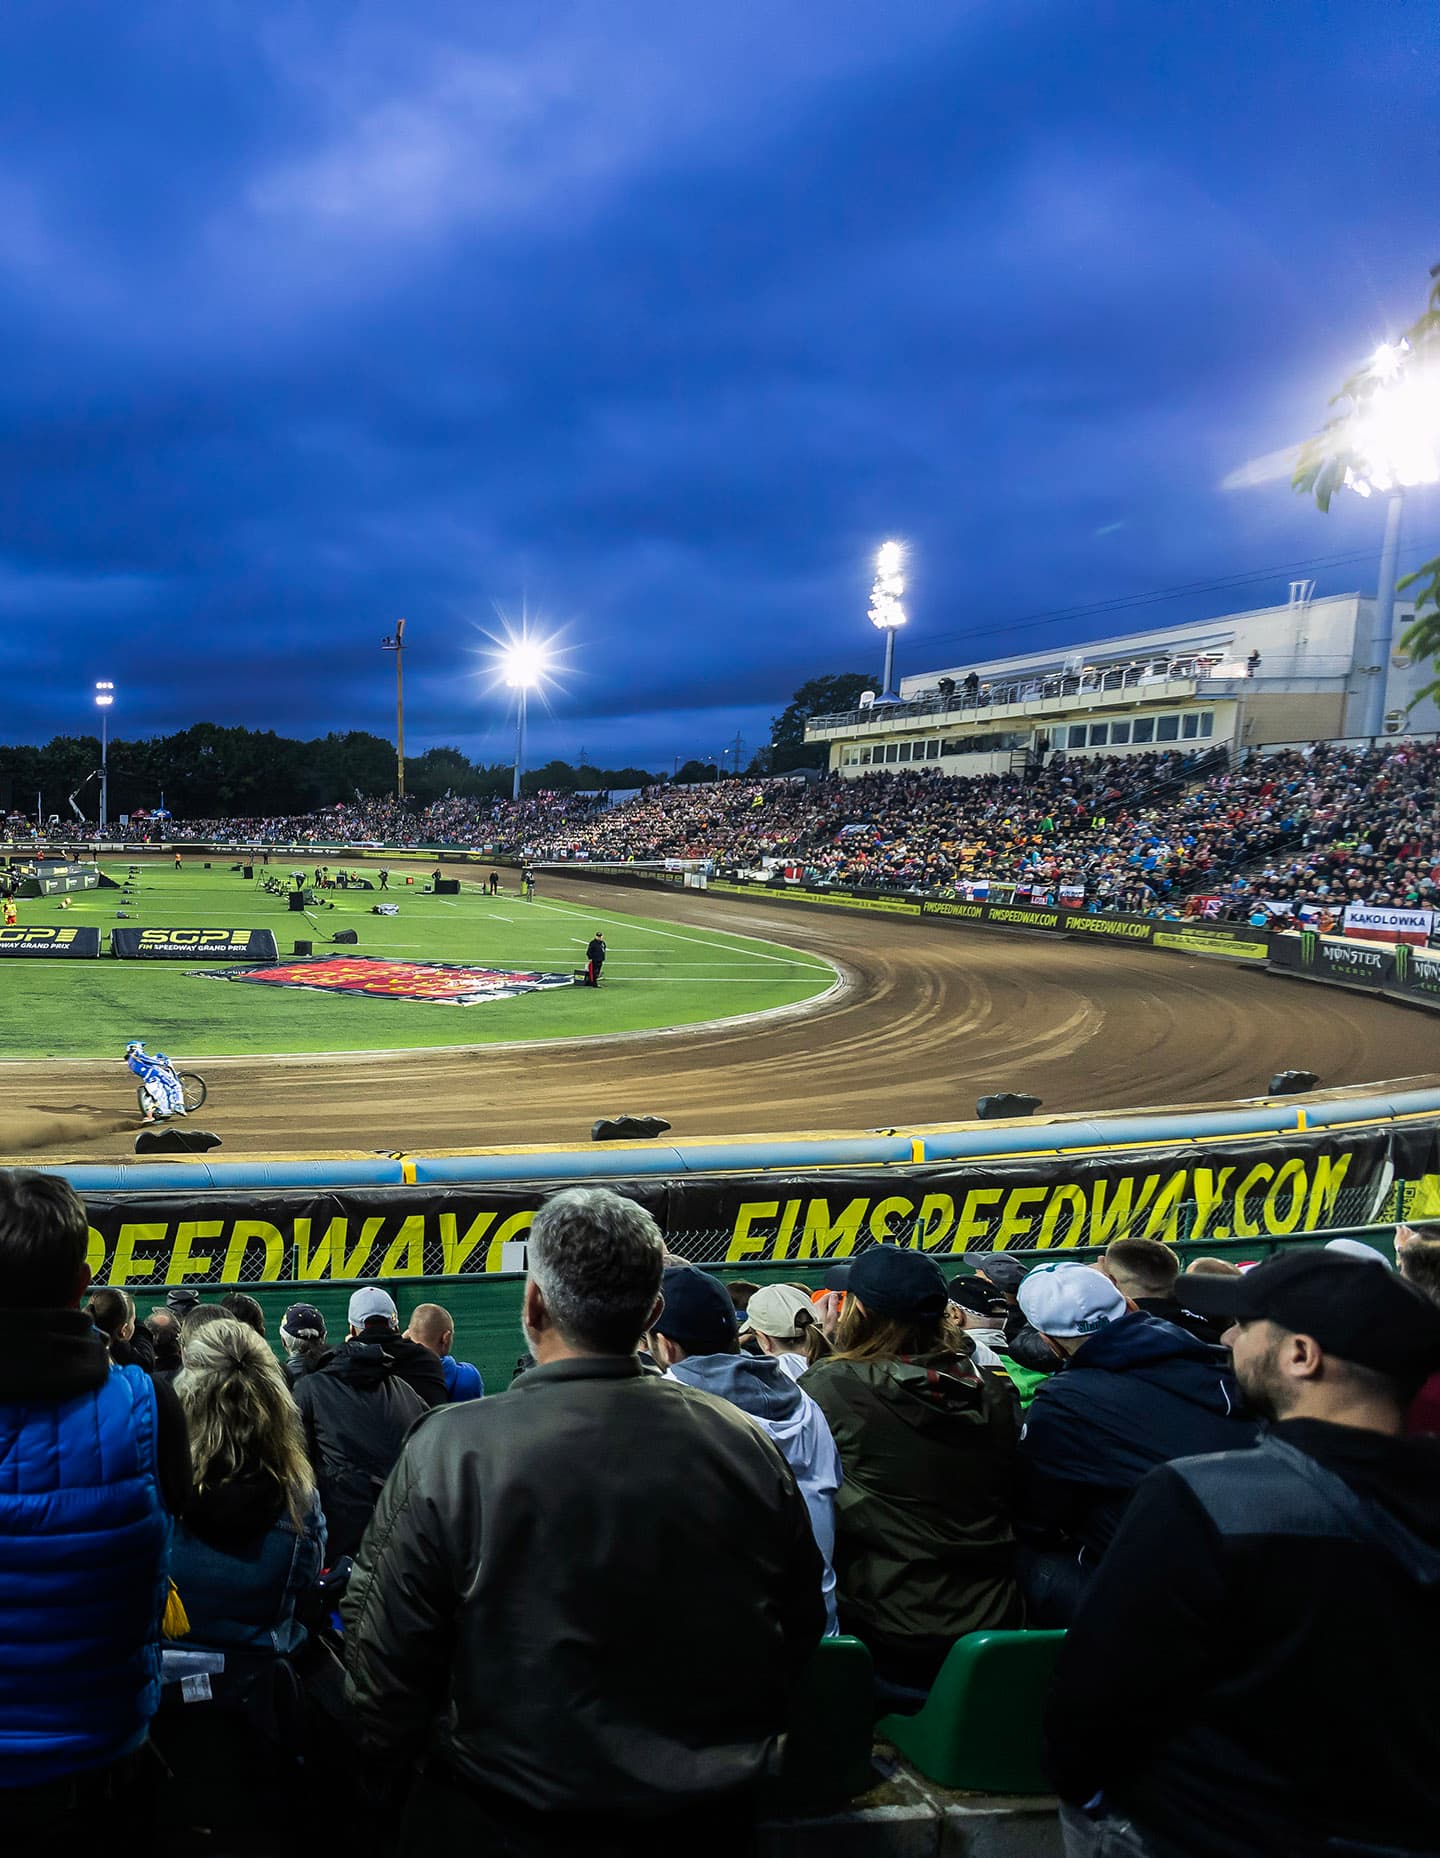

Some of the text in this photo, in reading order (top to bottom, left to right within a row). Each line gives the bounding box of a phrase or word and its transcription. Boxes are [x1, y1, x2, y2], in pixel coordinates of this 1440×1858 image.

[923, 901, 983, 918] FIMSPEEDWAY.COM
[988, 908, 1059, 927] FIMSPEEDWAY.COM
[1065, 916, 1151, 938] FIMSPEEDWAY.COM
